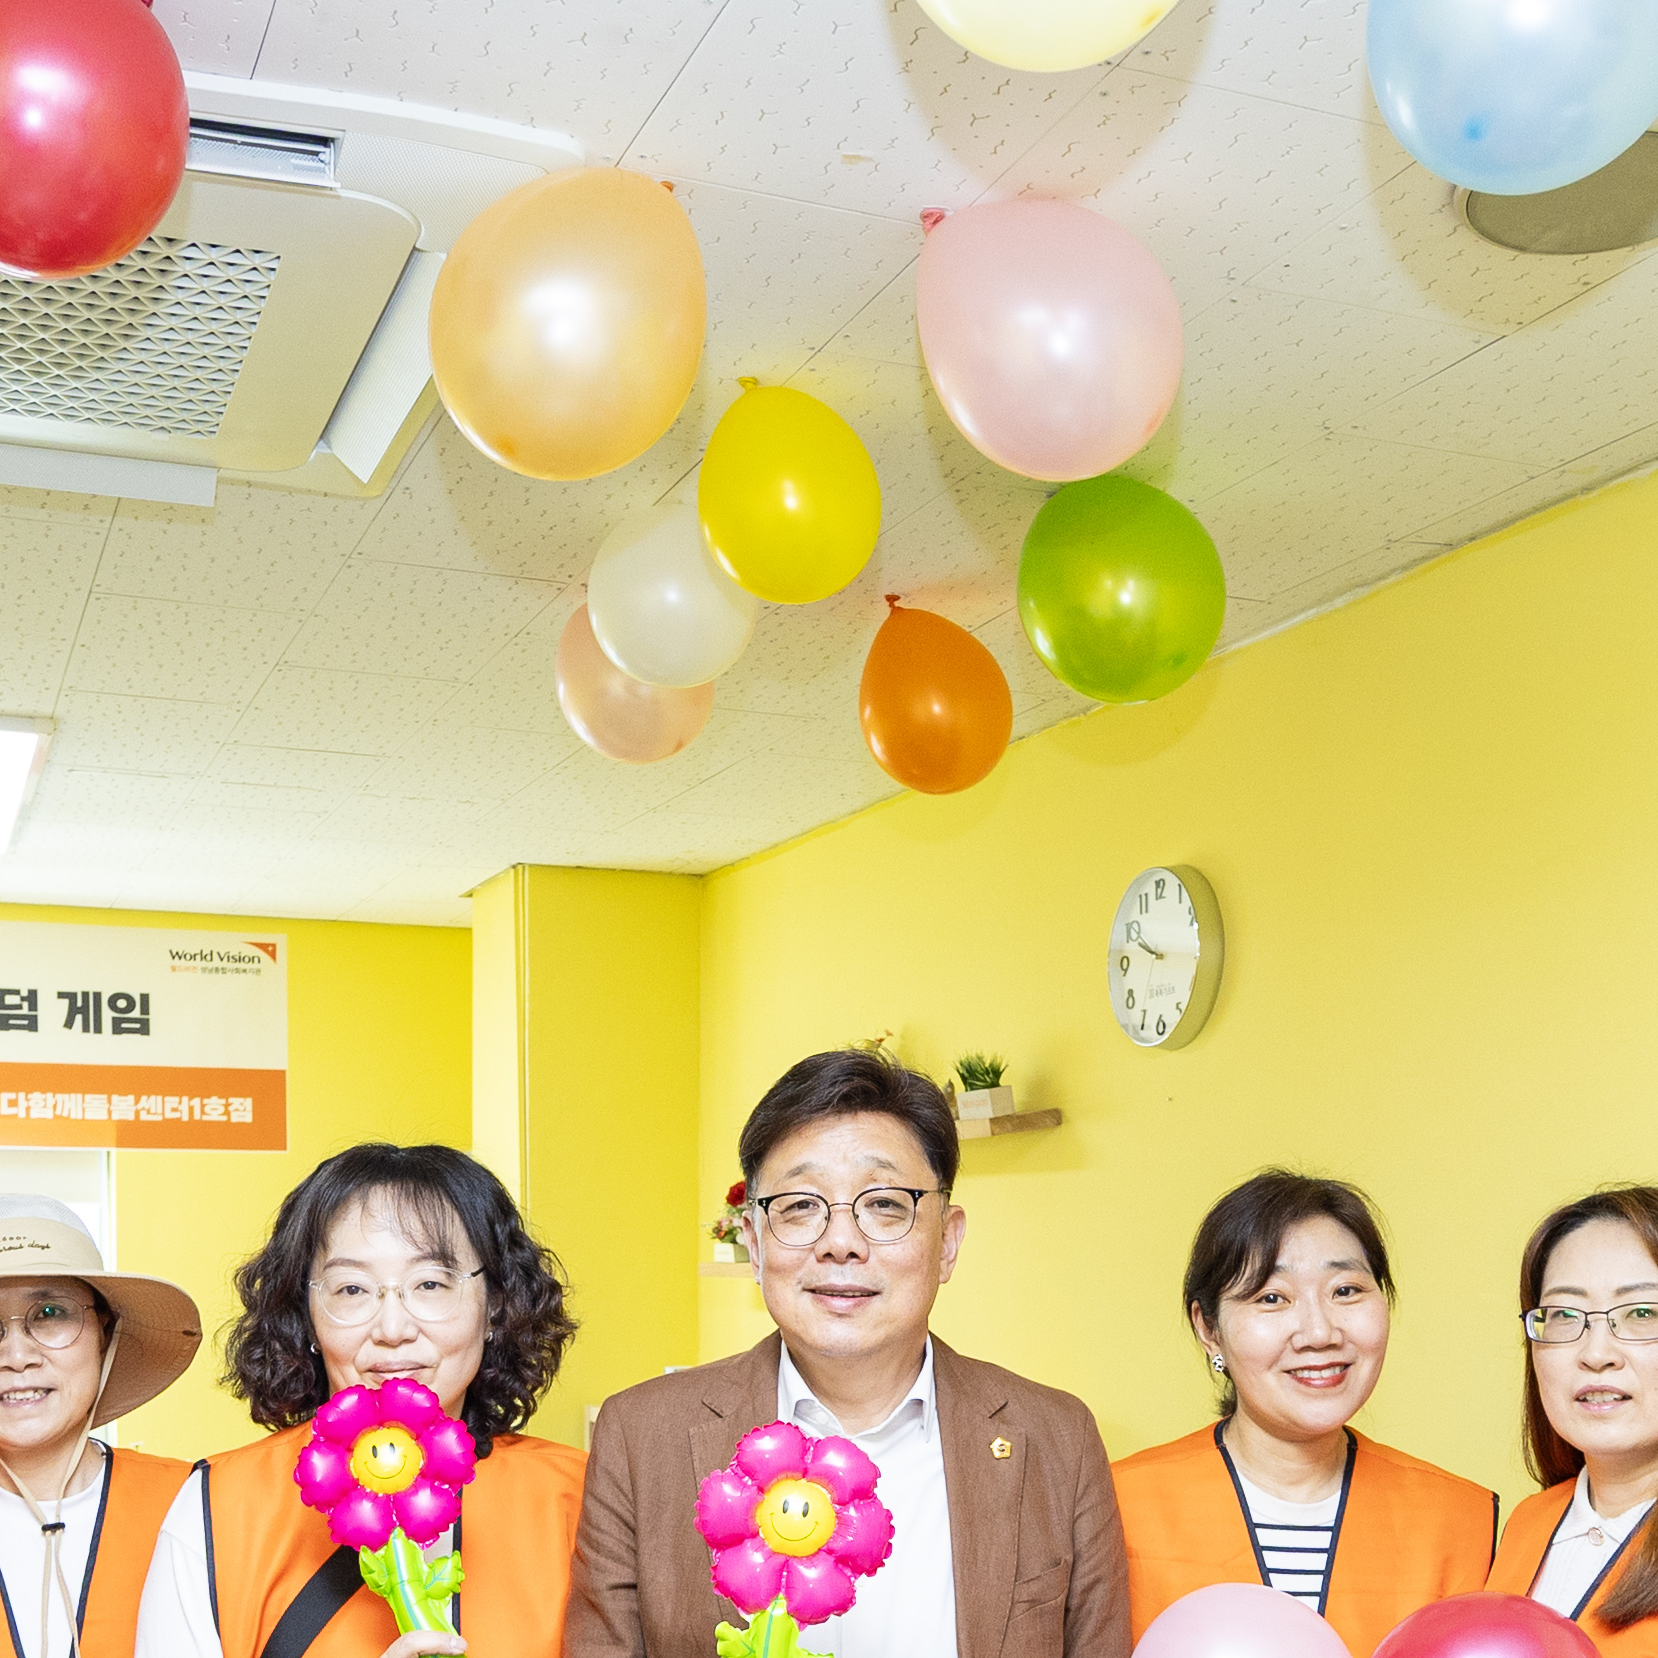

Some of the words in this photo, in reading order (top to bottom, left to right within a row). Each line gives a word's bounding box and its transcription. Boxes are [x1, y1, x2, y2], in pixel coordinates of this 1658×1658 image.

[1155, 878, 1166, 900] 12
[1139, 892, 1149, 915] 11
[1125, 920, 1141, 943] 10
[169, 949, 213, 962] World
[216, 951, 261, 964] Vision
[1120, 955, 1130, 977] 9
[1126, 988, 1135, 1010] 8
[56, 991, 150, 1036] 게임
[1156, 1014, 1166, 1036] 6
